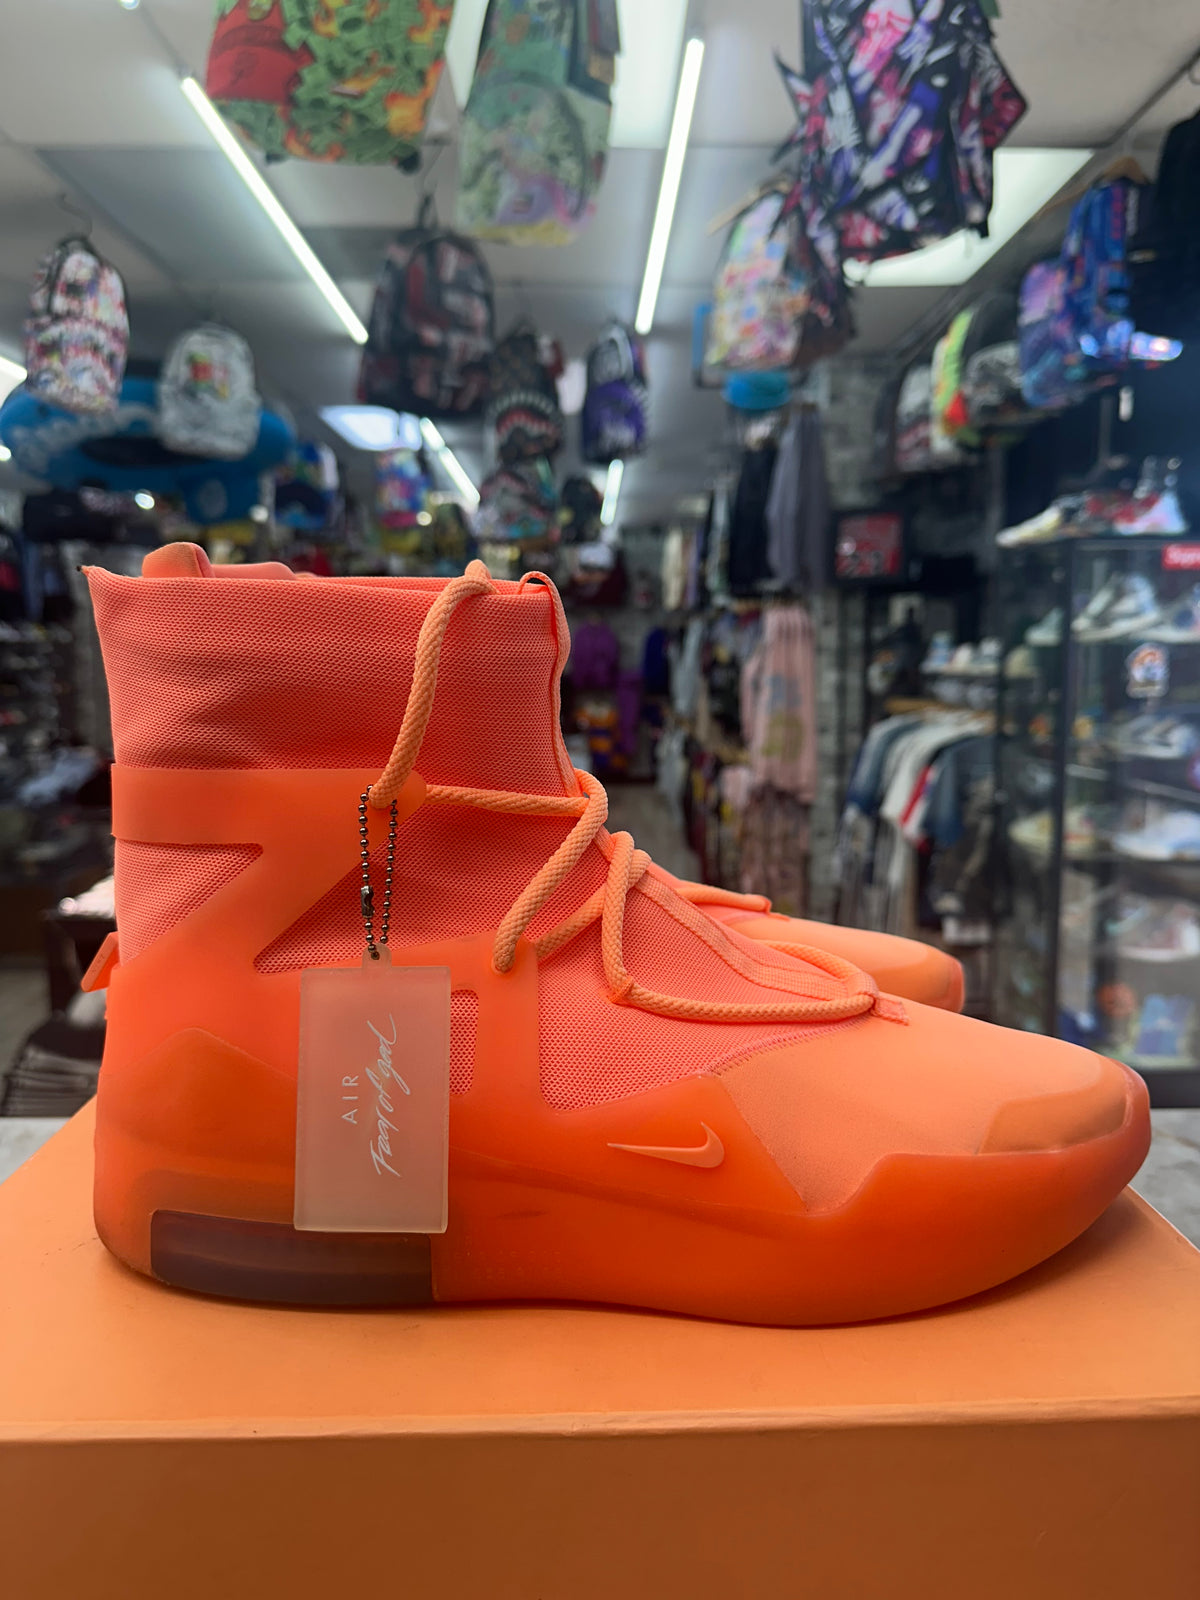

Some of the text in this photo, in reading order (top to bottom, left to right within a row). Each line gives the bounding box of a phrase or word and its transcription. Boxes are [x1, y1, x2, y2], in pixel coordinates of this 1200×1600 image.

[341, 1075, 359, 1125] AIR
[365, 1067, 394, 1113] of
[370, 1105, 402, 1178] Fear
